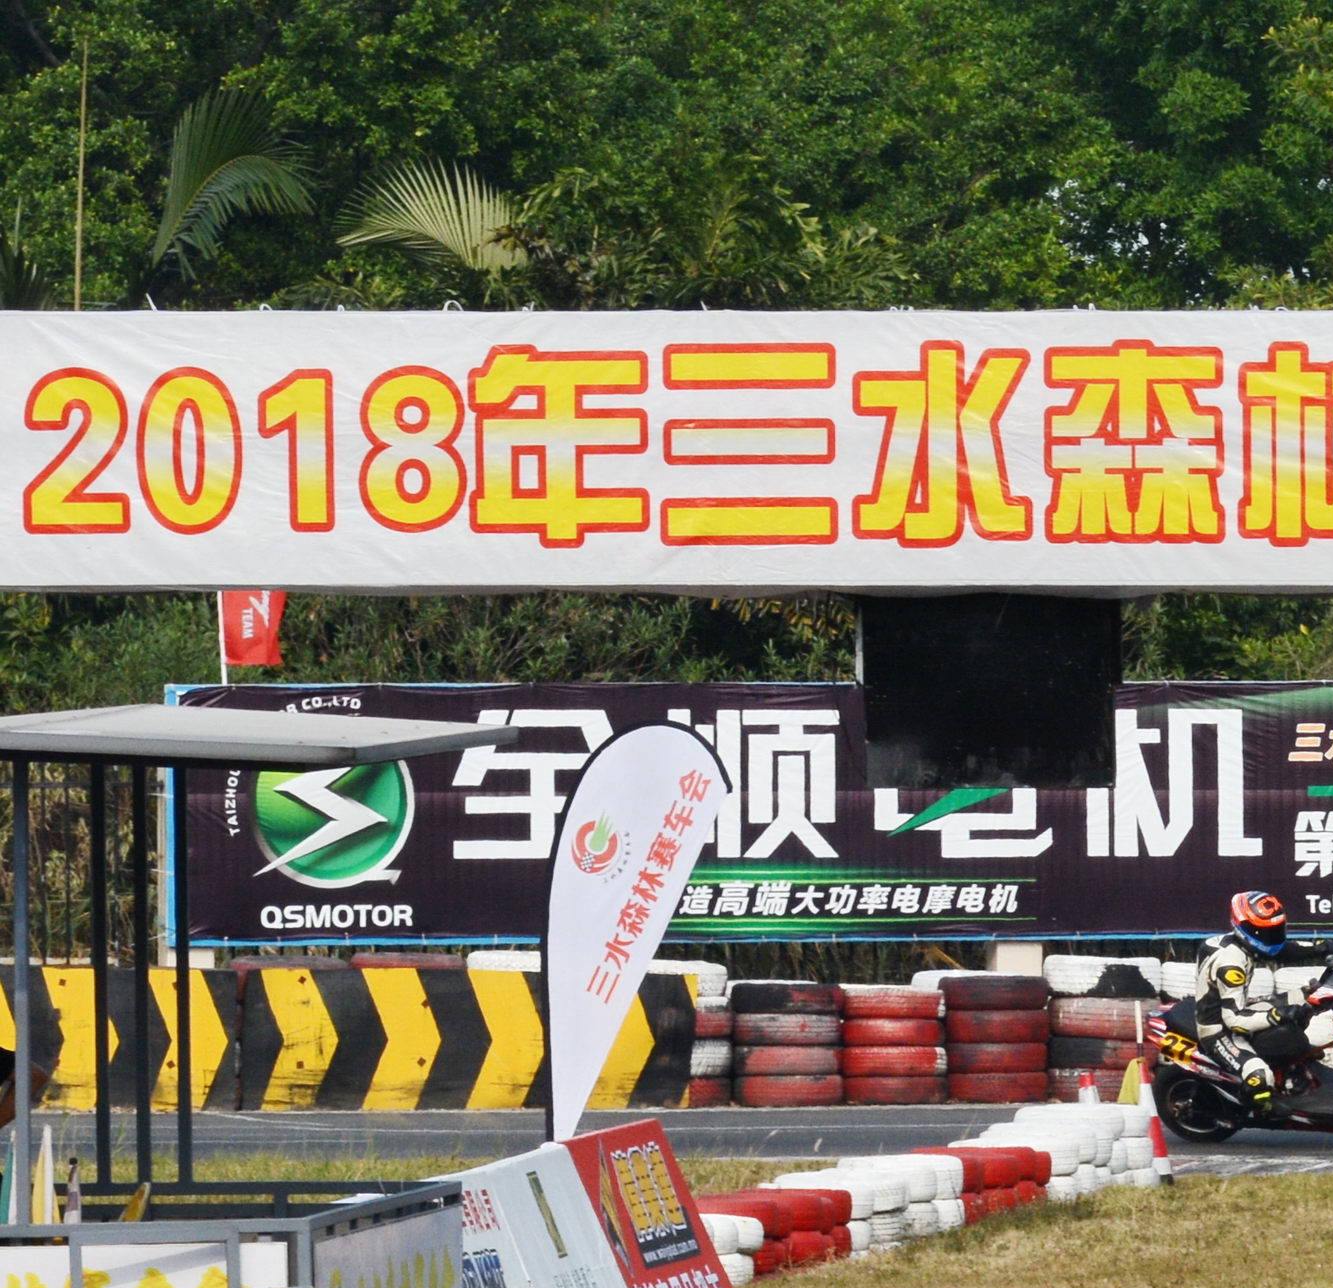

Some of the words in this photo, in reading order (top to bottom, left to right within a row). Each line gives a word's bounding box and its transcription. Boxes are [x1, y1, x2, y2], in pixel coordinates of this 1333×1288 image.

[587, 769, 712, 1004] 三水森林赛车会
[679, 881, 1019, 916] 造高端大功率电摩电机
[260, 904, 413, 928] QSMOTOR
[1161, 1035, 1197, 1061] 27
